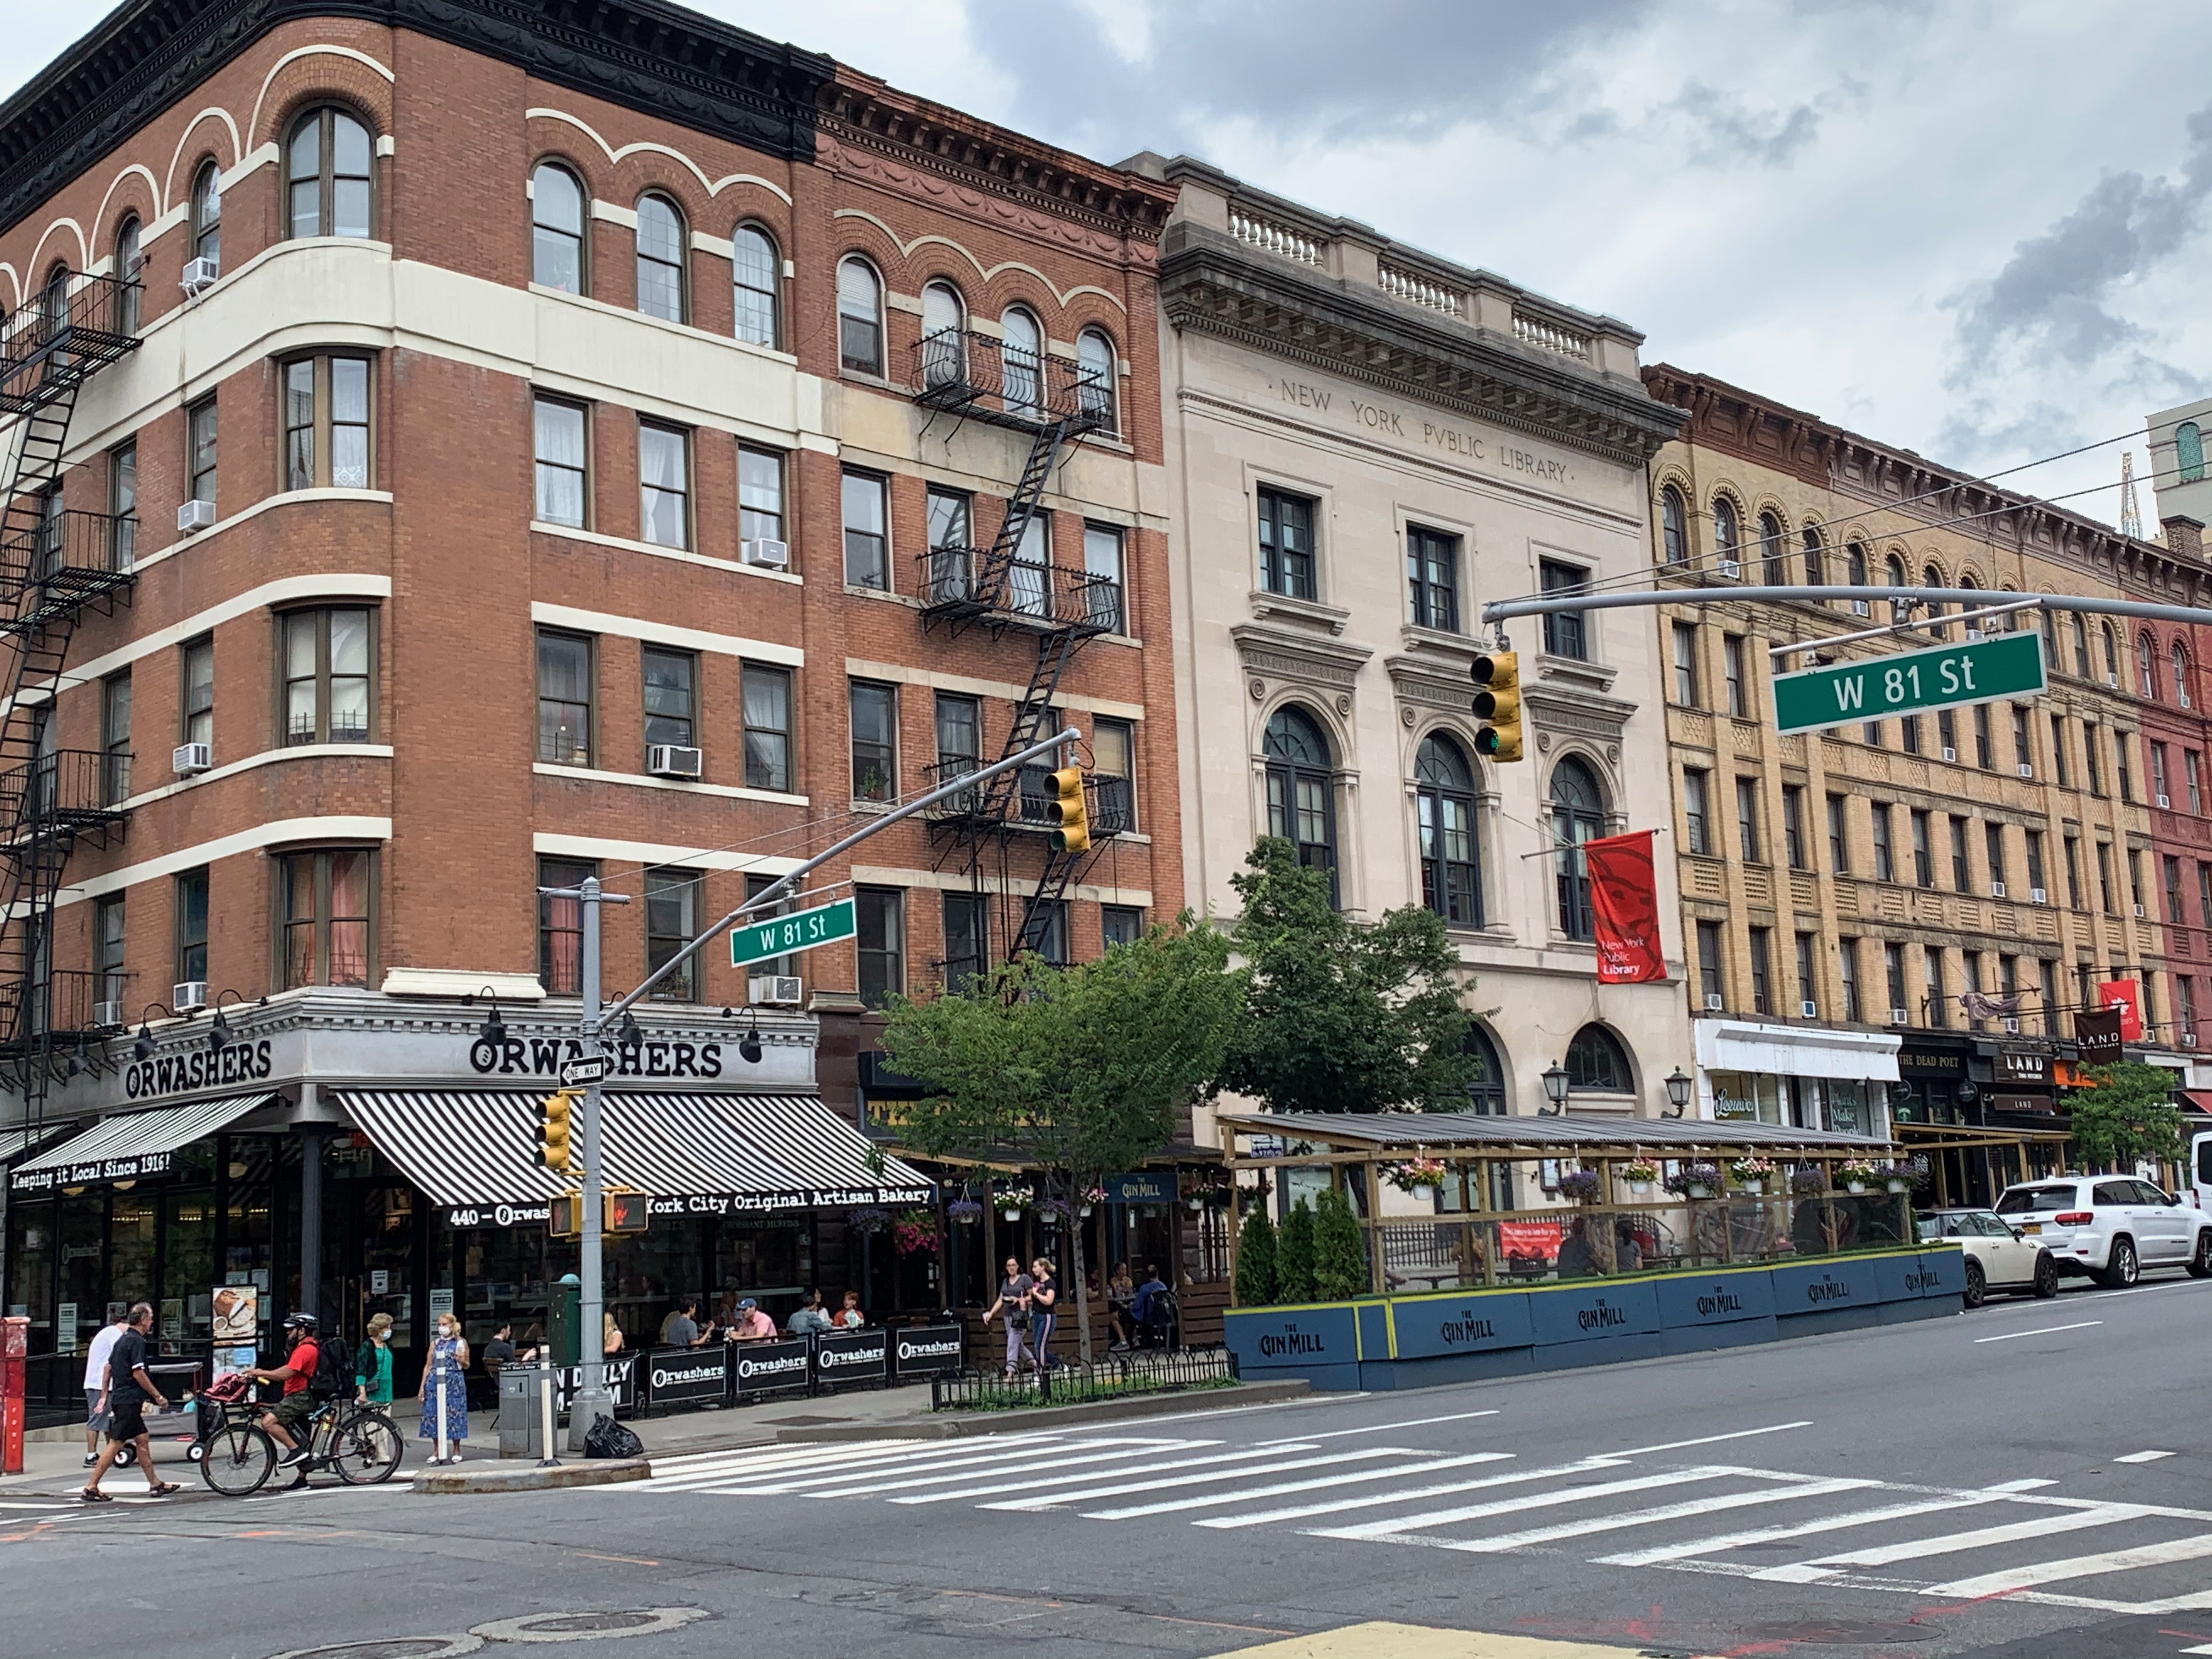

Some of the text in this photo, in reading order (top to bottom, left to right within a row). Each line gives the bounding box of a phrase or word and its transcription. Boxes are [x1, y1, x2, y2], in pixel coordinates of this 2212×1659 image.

[1280, 379, 1331, 411] NEW
[1350, 400, 1404, 436] YORK
[1499, 446, 1567, 483] LIBRARY
[1833, 656, 1976, 711] W 81 St
[760, 915, 826, 951] W 81 St
[1602, 937, 1645, 950] New York
[1604, 951, 1630, 962] Public
[1603, 964, 1640, 975] Library
[2078, 1032, 2119, 1046] LAND
[126, 1040, 271, 1099] ORWASHERS
[566, 1064, 599, 1079] ONE WAY
[1899, 1054, 1959, 1068] THE DEAD POET
[2006, 1056, 2043, 1071] LAND
[1832, 1109, 1854, 1122] Make
[12, 1154, 171, 1191] Keeping it Local Since 1916!
[1122, 1183, 1160, 1199] GIN MILL
[450, 1210, 478, 1226] 440
[495, 1205, 550, 1227] Orwas
[646, 1197, 684, 1214] York
[689, 1195, 729, 1214] City
[735, 1190, 808, 1211] Original
[813, 1187, 874, 1206] Artisan
[878, 1187, 931, 1204] Bakery
[1808, 1282, 1848, 1304] GIN MILL
[1697, 1295, 1741, 1317] GIN MILL
[1578, 1307, 1626, 1331] GIN MILL
[1443, 1320, 1494, 1345] GIN MILL
[899, 1341, 960, 1359] Orwashers
[1261, 1334, 1324, 1357] GIN MILL
[739, 1355, 806, 1378] Orwashers
[820, 1347, 885, 1368] Orwashers
[573, 1361, 631, 1387] DILY
[652, 1365, 725, 1388] Orwashers
